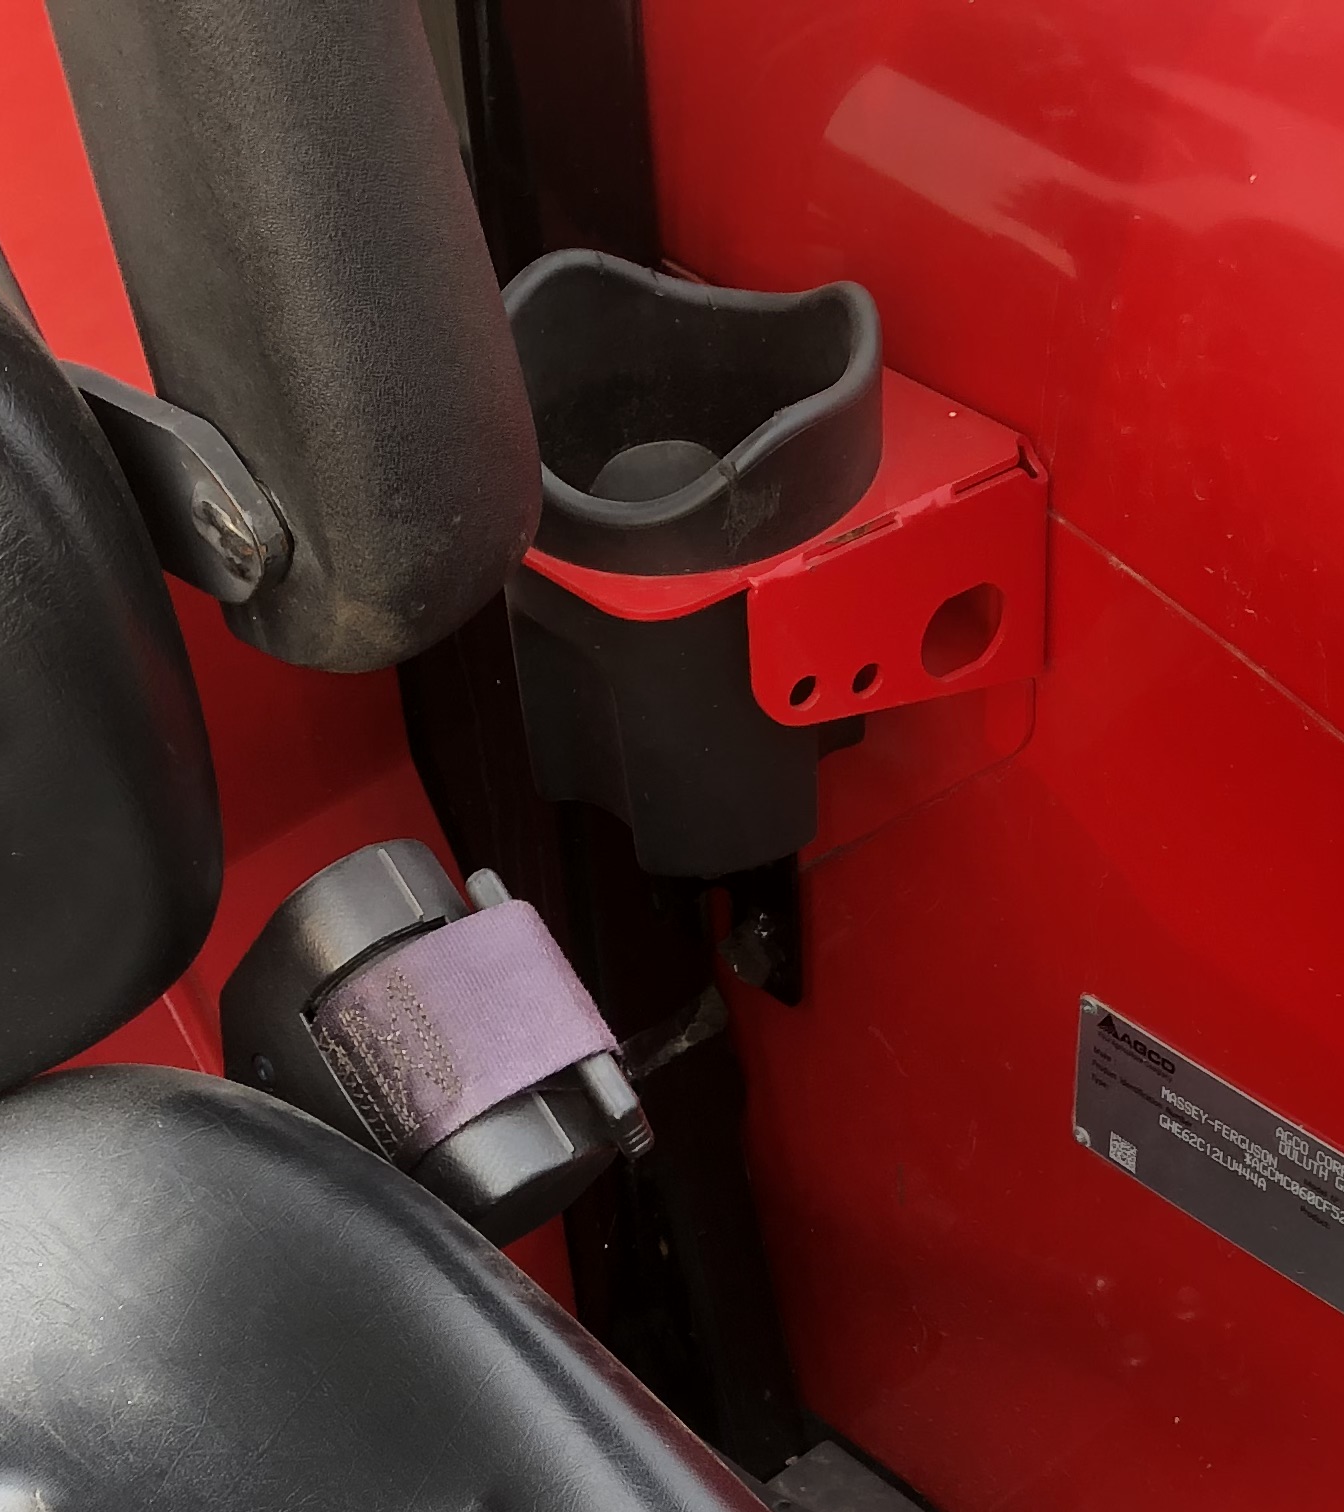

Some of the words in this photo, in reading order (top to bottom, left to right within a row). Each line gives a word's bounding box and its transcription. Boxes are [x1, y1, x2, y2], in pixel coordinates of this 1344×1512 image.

[1120, 1032, 1176, 1075] AGCO
[1160, 1085, 1278, 1169] MASSEY-FERGUSON
[1275, 1126, 1310, 1156] AGCO
[1278, 1141, 1329, 1181] DULUTH
